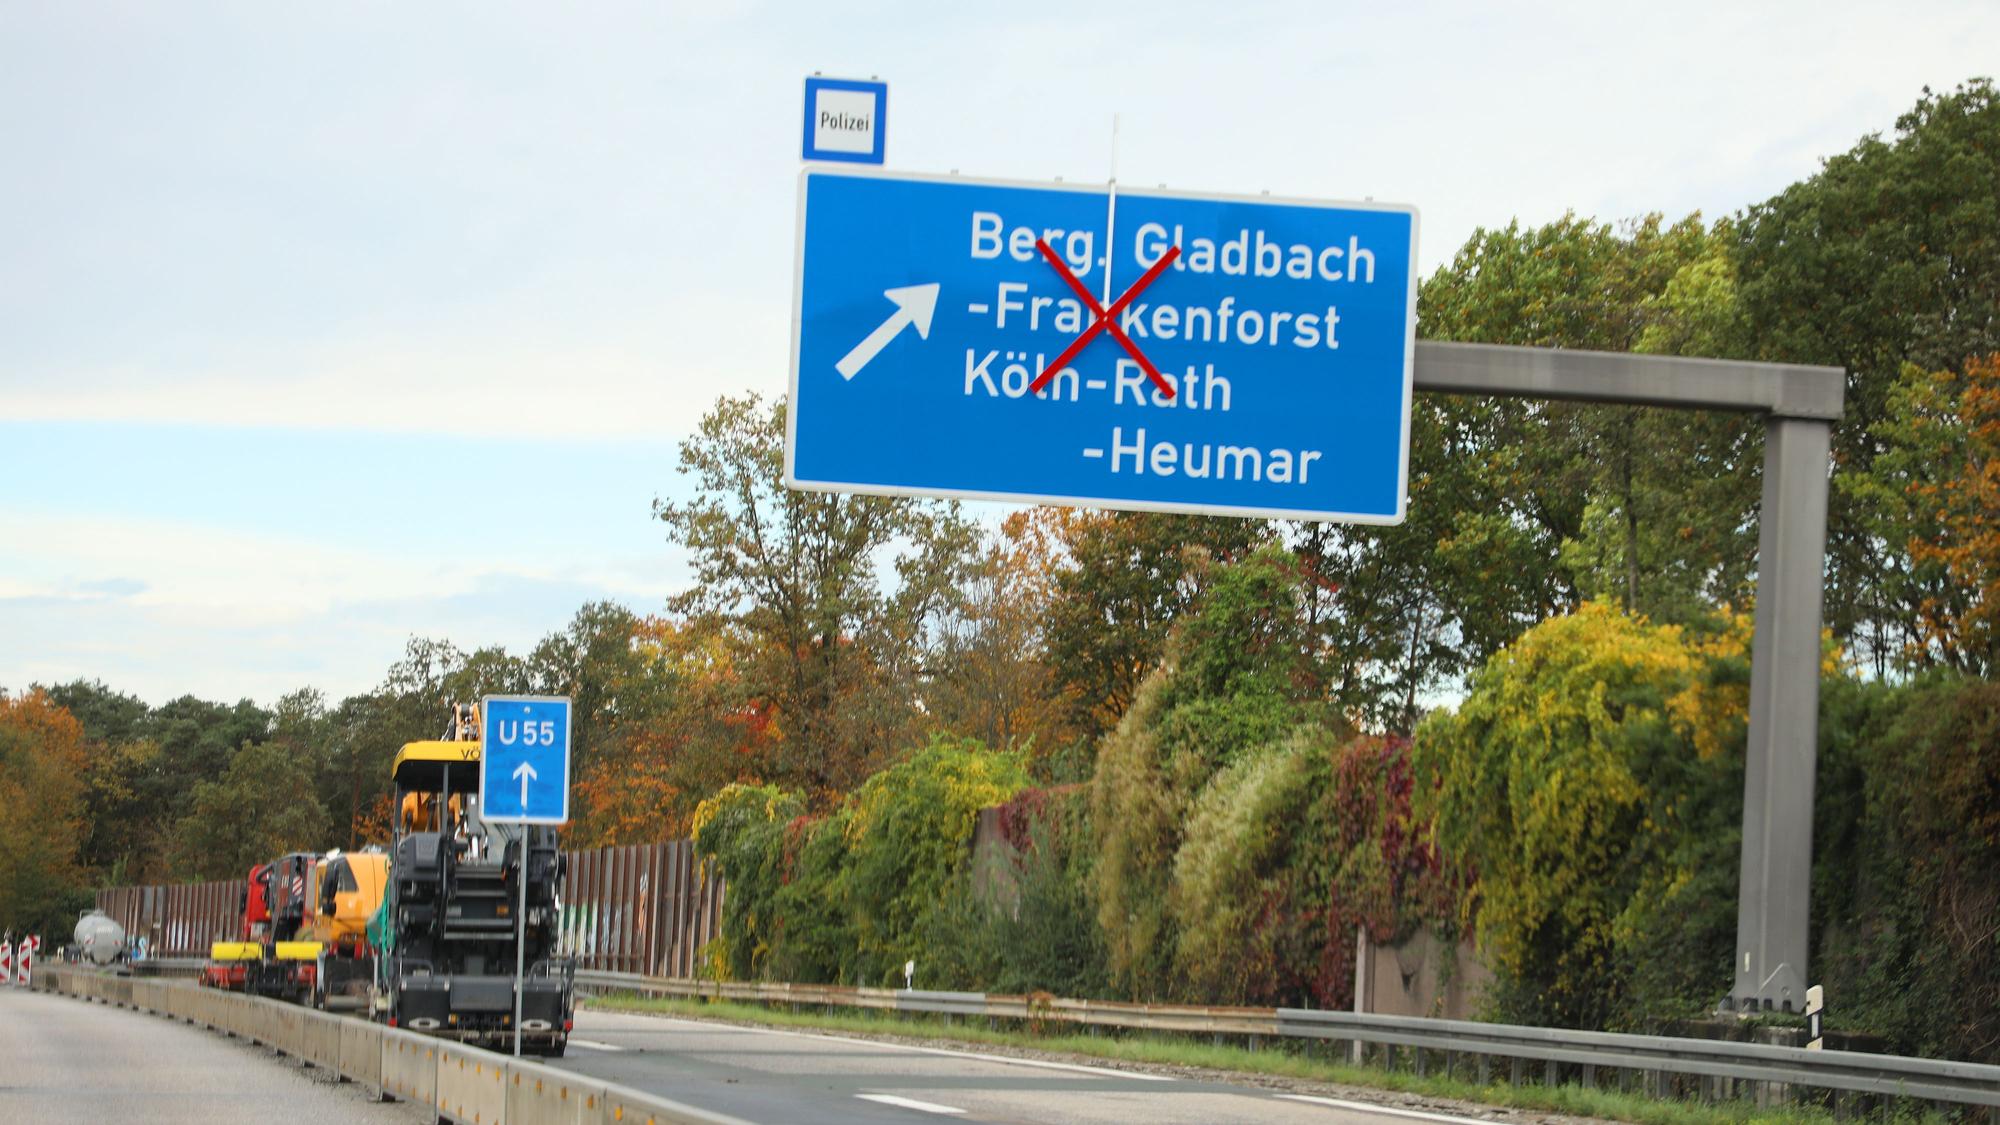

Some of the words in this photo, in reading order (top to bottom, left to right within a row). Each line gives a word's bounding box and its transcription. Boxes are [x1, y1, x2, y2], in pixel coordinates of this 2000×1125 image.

[821, 111, 869, 131] Polizei
[970, 211, 1107, 278] Berg.
[1134, 222, 1376, 283] Gladbach
[964, 348, 1232, 411] Köln-Rath
[1083, 426, 1323, 484] -Heumar
[523, 720, 554, 746] 55
